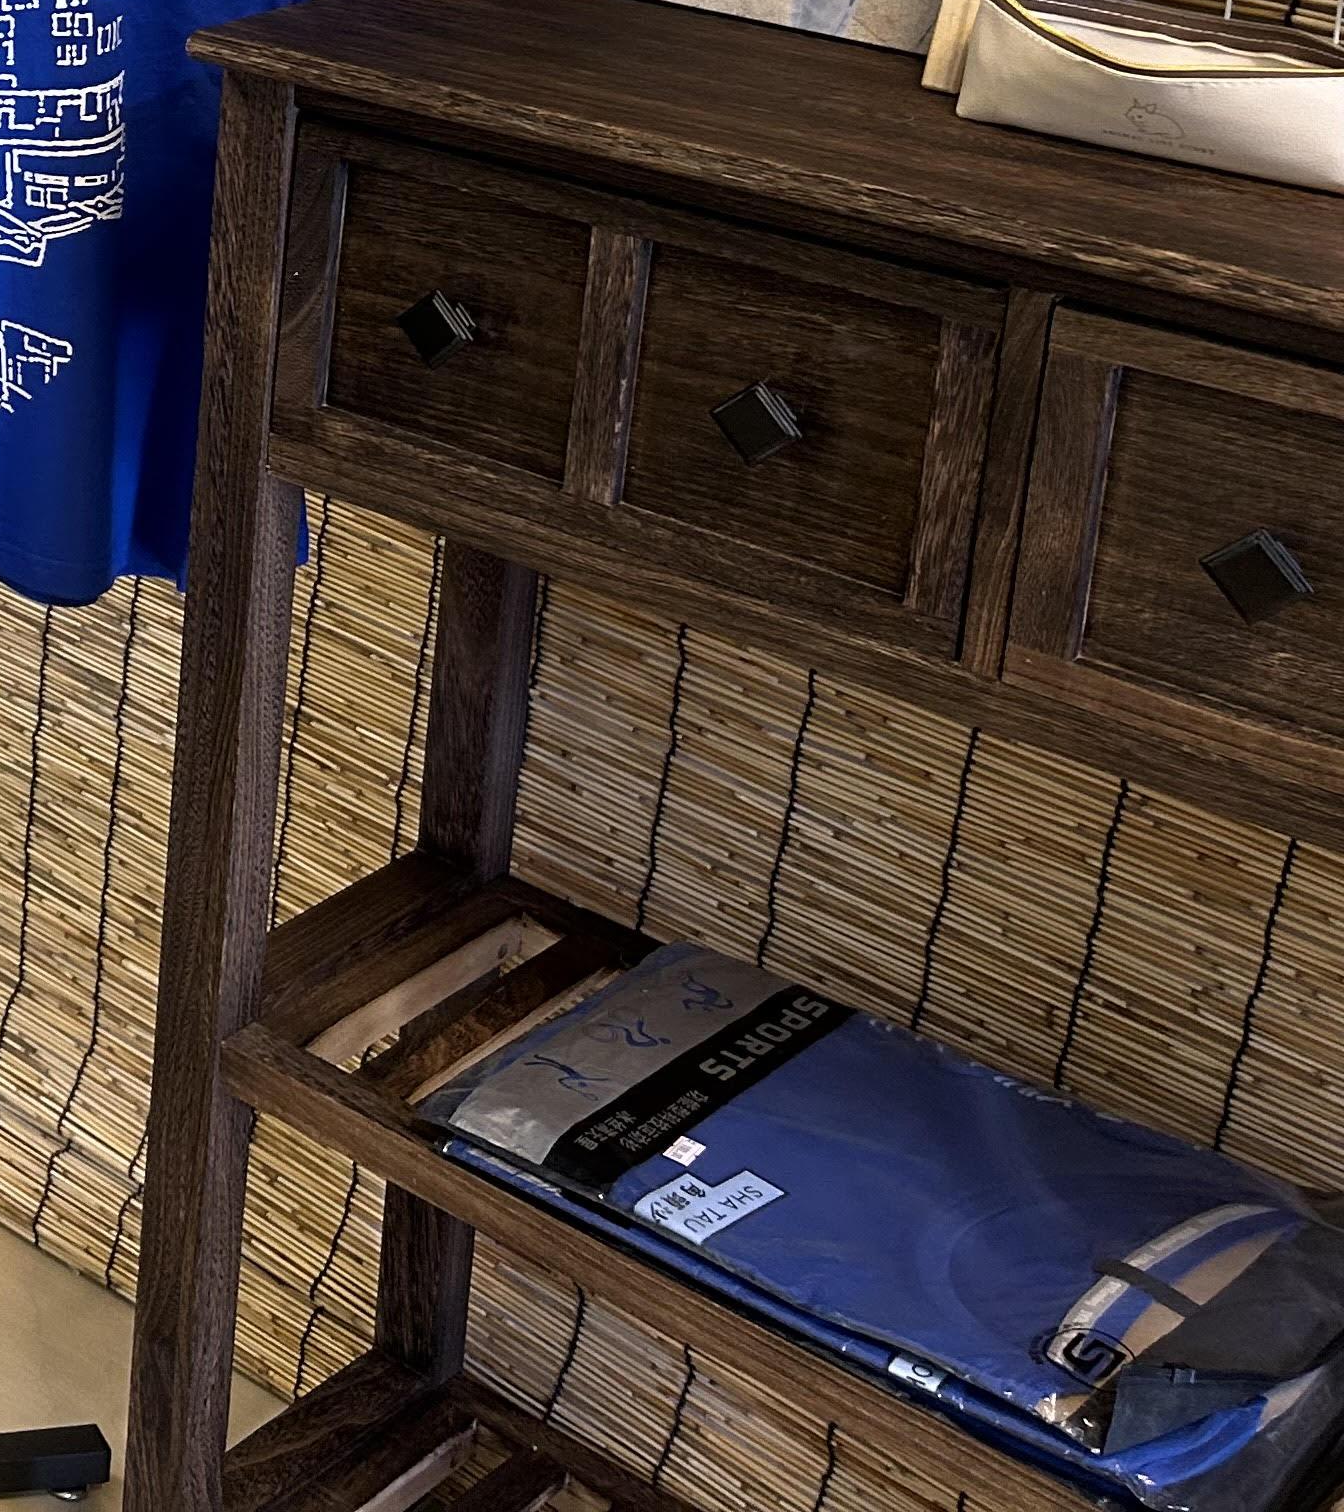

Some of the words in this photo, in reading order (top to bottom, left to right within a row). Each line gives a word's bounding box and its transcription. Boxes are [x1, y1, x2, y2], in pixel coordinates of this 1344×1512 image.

[699, 996, 829, 1081] SPORTS
[718, 1185, 763, 1210] SHA
[683, 1208, 727, 1233] TAU
